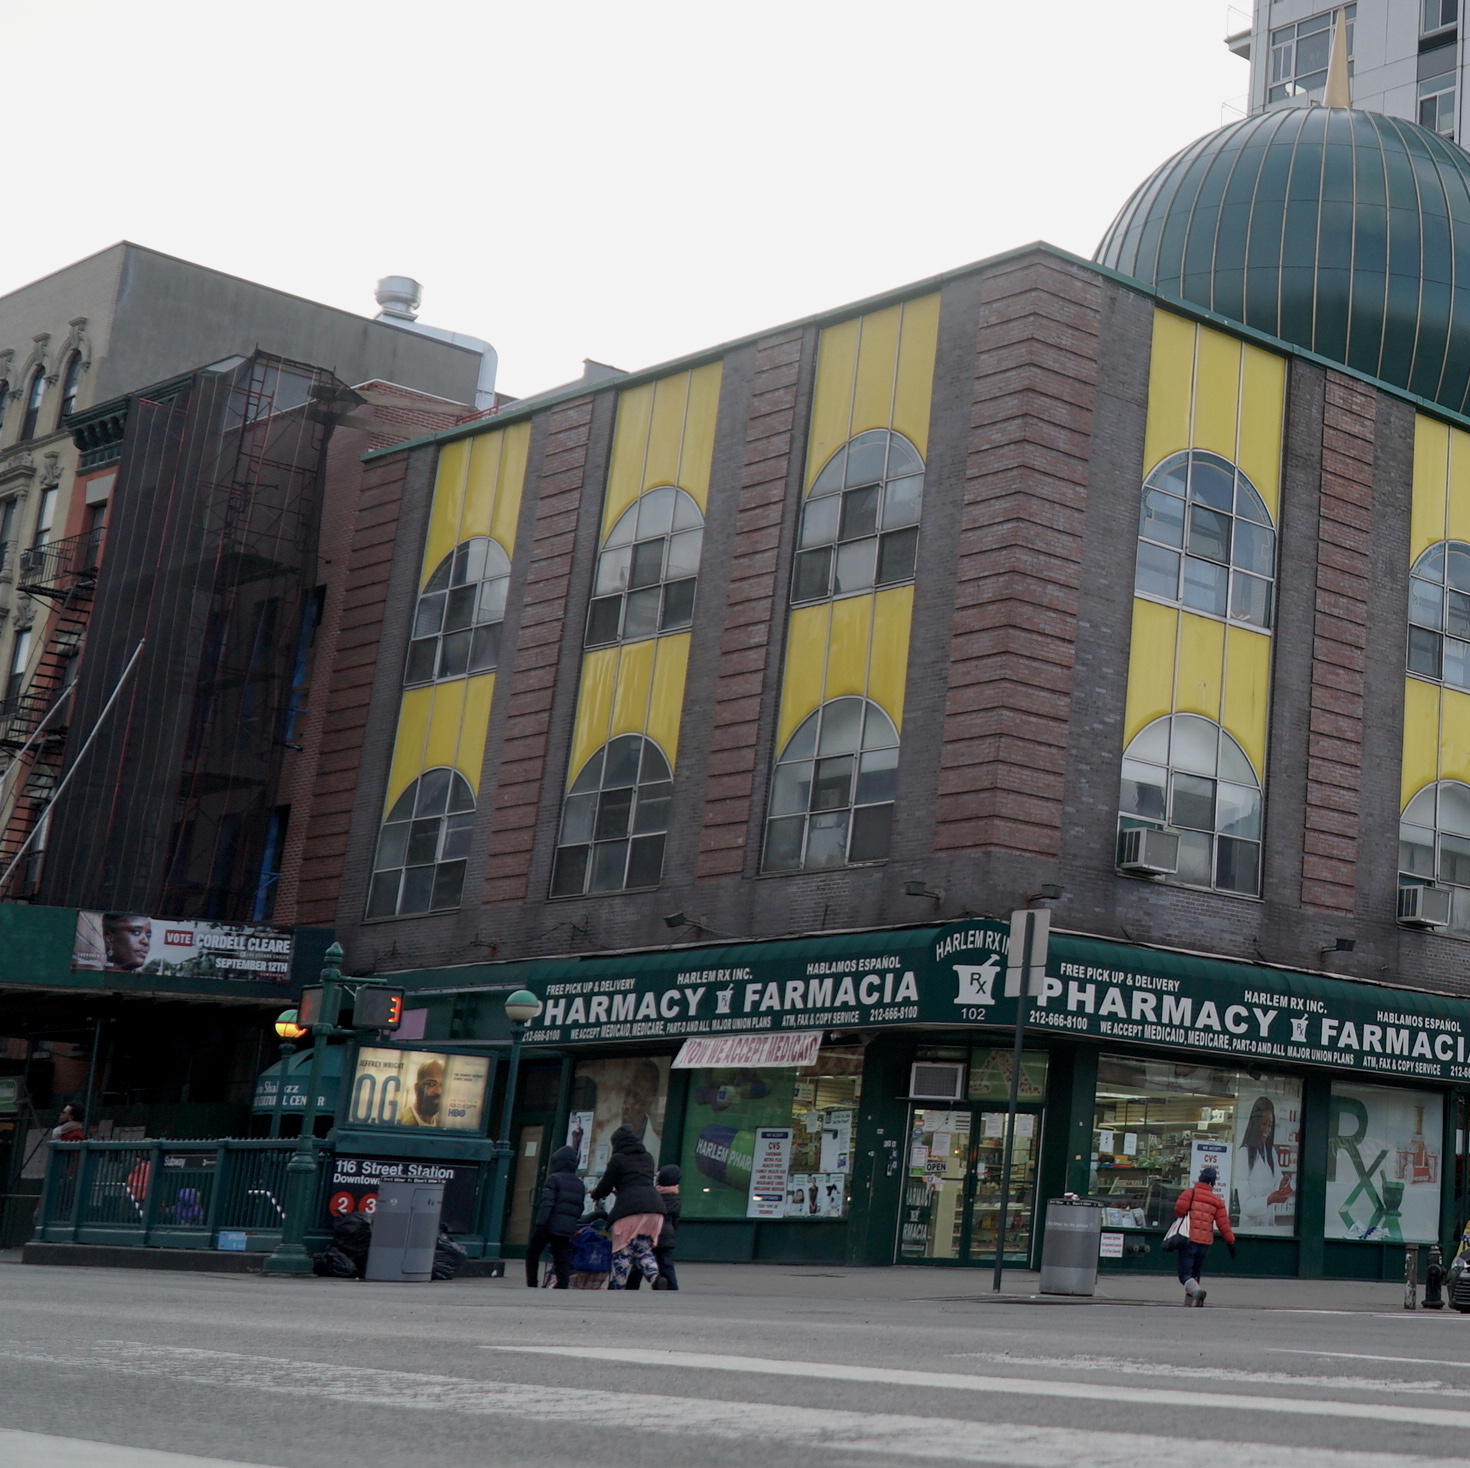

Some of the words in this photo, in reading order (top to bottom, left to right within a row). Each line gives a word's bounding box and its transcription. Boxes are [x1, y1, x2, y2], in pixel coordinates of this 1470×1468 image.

[166, 933, 192, 945] VOTE
[196, 933, 246, 951] CORDELL
[247, 937, 290, 953] CLEARE
[936, 930, 983, 962] HARLEM
[984, 931, 1000, 950] RX
[215, 957, 266, 972] SEPTEMBER
[267, 962, 288, 973] 12TH
[806, 961, 857, 976] HABLAMOS
[858, 954, 901, 972] ESPAÑOL
[677, 969, 716, 985] HARLEM
[716, 968, 731, 982] RX
[732, 967, 753, 980] INC.
[1060, 962, 1085, 978] FREE
[1086, 967, 1110, 982] PICK
[1112, 971, 1124, 984] UP
[1126, 973, 1134, 985] &
[1135, 974, 1180, 992] DELIVERY
[546, 983, 563, 996] FREE
[564, 982, 580, 994] PICK
[581, 981, 593, 993] UP
[594, 981, 599, 992] &
[600, 978, 636, 992] DELIVERY
[743, 970, 919, 1013] FARMACIA
[387, 996, 402, 1023] 3
[1036, 976, 1278, 1037] PHARMACY
[1244, 990, 1288, 1008] HARLEM
[1290, 996, 1304, 1010] RX
[1306, 998, 1328, 1014] INC.
[782, 1015, 796, 1027] ATM,
[796, 1014, 809, 1026] FAX
[810, 1013, 814, 1025] &
[814, 1012, 832, 1025] COPY
[833, 1010, 860, 1024] SERVICE
[870, 1006, 918, 1022] 212-666-8100
[961, 1008, 986, 1020] 102
[1029, 1010, 1088, 1030] 212-666-8100
[1376, 1010, 1424, 1028] HABLAMOS
[1424, 1016, 1462, 1033] ESPAÑOL
[570, 1028, 582, 1040] WE
[582, 1026, 601, 1039] ACCEPT
[600, 1024, 632, 1038] MEDICAID,
[632, 1022, 666, 1037] MEDICARE,
[666, 1022, 685, 1034] PART-D
[685, 1021, 698, 1032] AND
[698, 1020, 710, 1032] ALL
[712, 1018, 731, 1031] MAJOR
[732, 1018, 751, 1030] UNION
[752, 1016, 772, 1028] PLANS
[680, 1040, 710, 1064] NOW
[707, 1039, 728, 1064] WE
[725, 1036, 769, 1064] ACCEPT
[765, 1034, 817, 1063] MEDICAID
[1100, 1020, 1112, 1034] WE
[1112, 1023, 1143, 1038] ACCEPT
[1144, 1024, 1187, 1045] MEDICAID,
[1188, 1030, 1232, 1051] MEDICARE,
[1232, 1038, 1256, 1052] PART-D
[1257, 1041, 1272, 1054] AND
[1273, 1044, 1286, 1056] ALL
[1287, 1045, 1310, 1060] MAJOR
[1311, 1048, 1332, 1062] UNION
[1333, 1052, 1354, 1066] PLANS
[359, 1059, 382, 1068] JEFFREY
[383, 1061, 404, 1070] WRIGHT
[1363, 1055, 1378, 1070] ATM,
[1378, 1057, 1392, 1070] FAX
[1392, 1059, 1398, 1070] &
[1398, 1060, 1414, 1074] COPY
[1414, 1061, 1441, 1076] SERVICE
[448, 1108, 466, 1118] HBO
[696, 1138, 729, 1163] HARLEM
[768, 1142, 780, 1150] CVS
[926, 1162, 946, 1172] OPEN
[1204, 1155, 1218, 1163] CVS
[336, 1160, 357, 1174] 116
[362, 1161, 404, 1176] Street
[408, 1164, 454, 1179] Station
[338, 1197, 349, 1213] 2
[364, 1198, 376, 1214] 3
